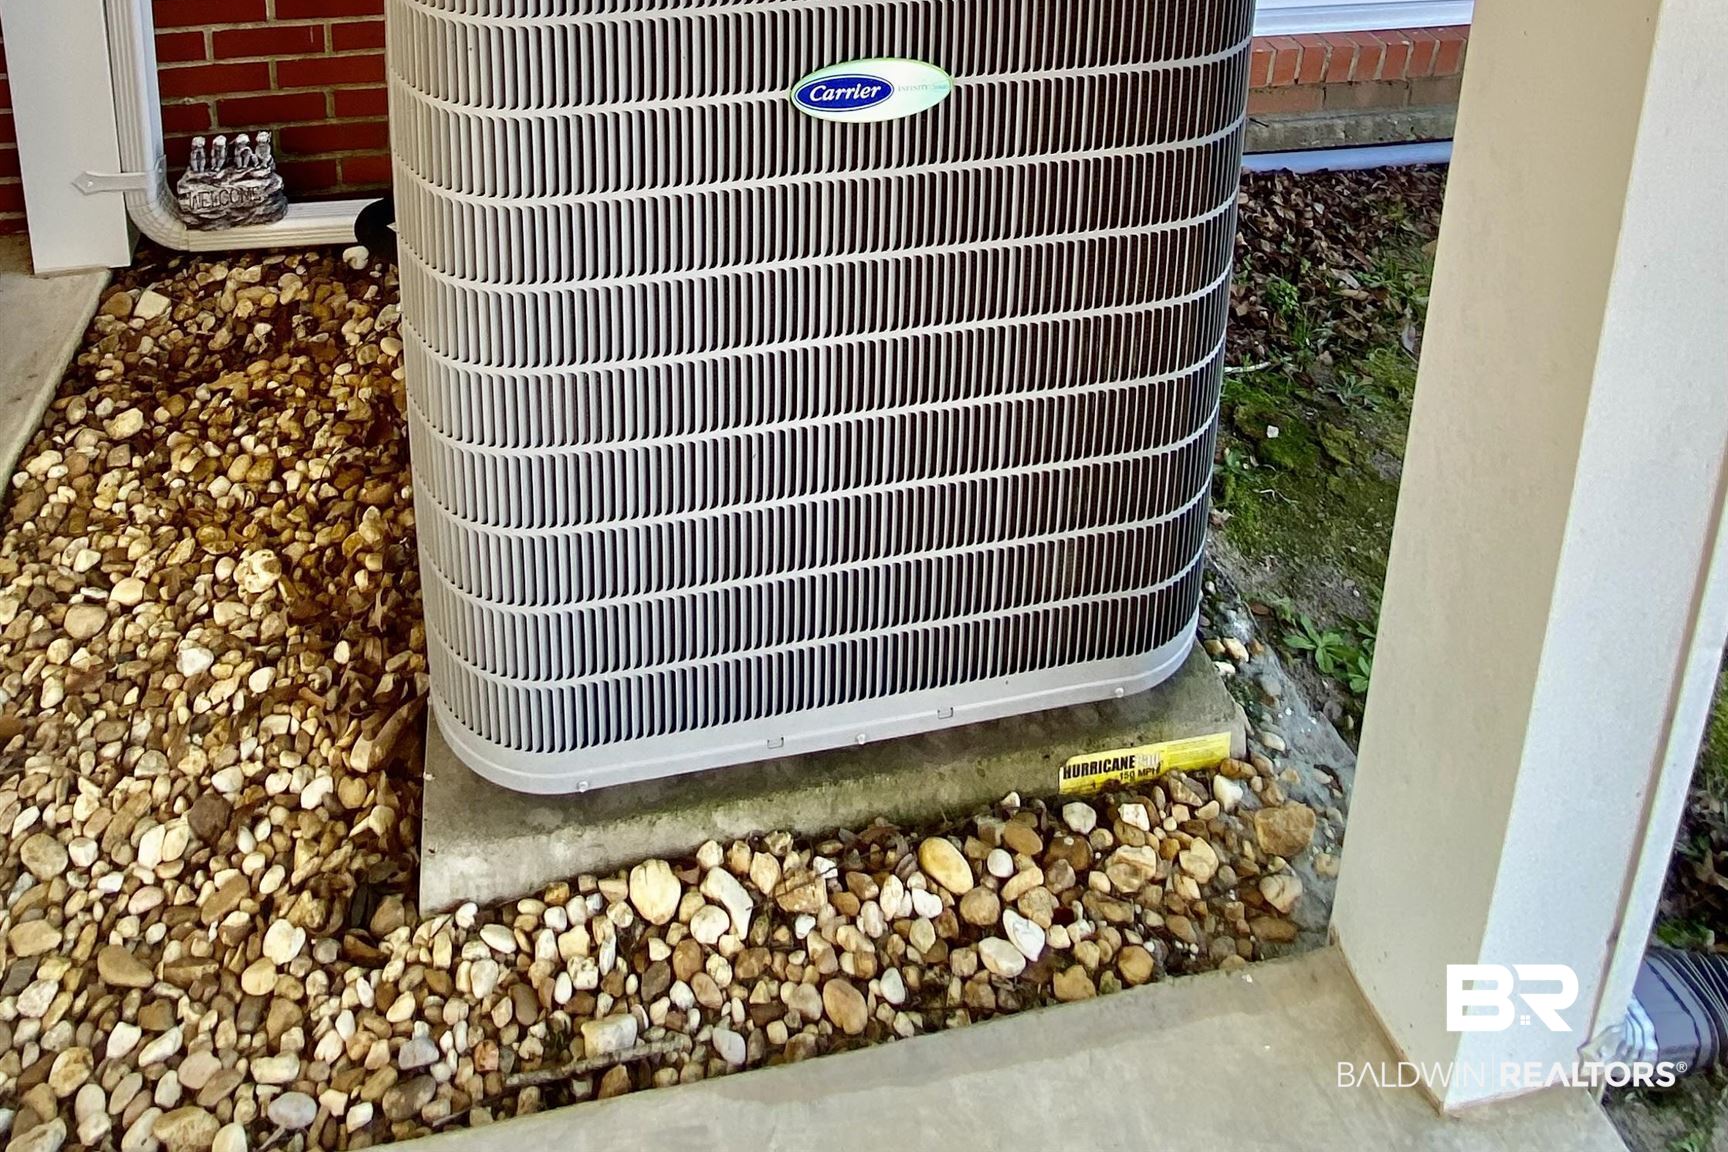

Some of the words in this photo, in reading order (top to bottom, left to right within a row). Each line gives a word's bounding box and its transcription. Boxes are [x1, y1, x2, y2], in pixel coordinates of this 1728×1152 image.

[809, 83, 882, 102] Carrier
[187, 186, 261, 209] WELCOME
[1063, 755, 1135, 780] HURRICANE
[1120, 770, 1135, 781] 150
